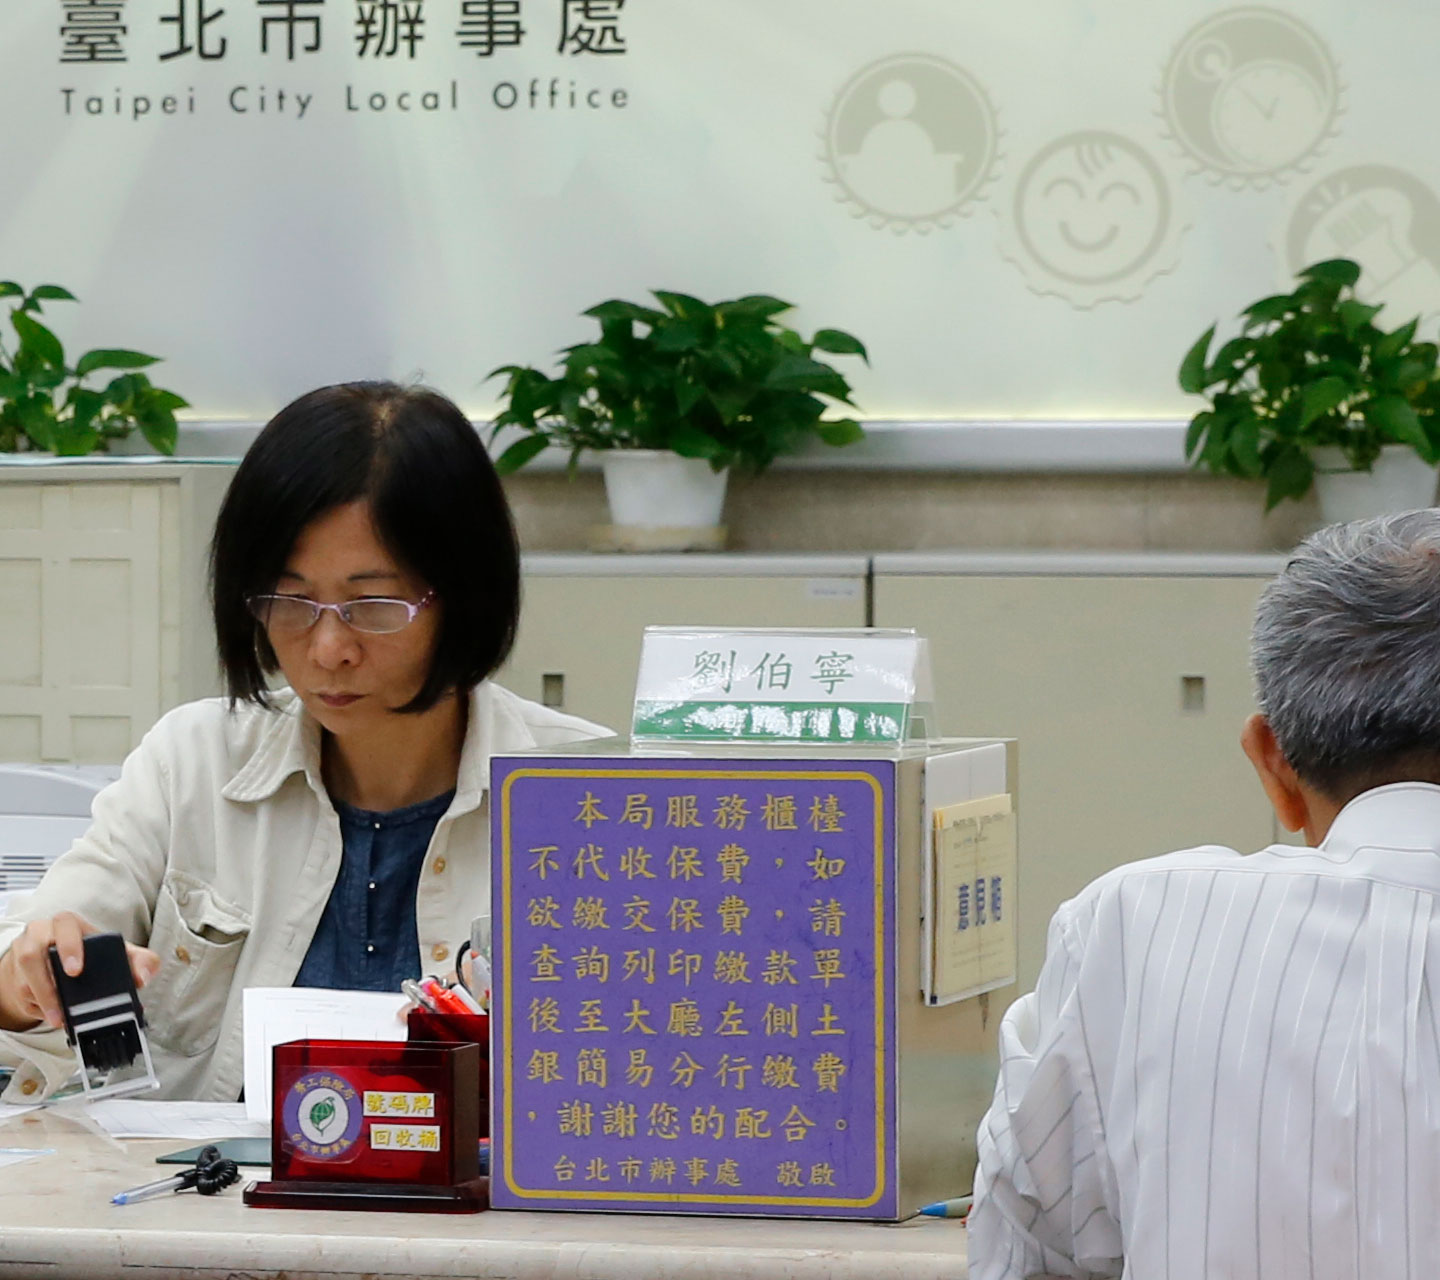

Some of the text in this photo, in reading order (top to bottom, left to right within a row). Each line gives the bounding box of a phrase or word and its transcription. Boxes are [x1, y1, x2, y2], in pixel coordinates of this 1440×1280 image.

[60, 78, 630, 119] Taipei City Local Office
[691, 649, 855, 695] 劉伯寧
[576, 792, 846, 834] 本局服務櫃檯
[528, 842, 847, 884] 不代收保費，如
[527, 894, 847, 937] 欲繳交保費，請
[529, 943, 847, 987] 查詢列印繳款單
[527, 996, 847, 1038] 後至大廳左側土
[527, 1047, 848, 1093] 銀簡易分行繳費
[365, 1093, 434, 1116] 號碼牌
[372, 1128, 438, 1149] 回收桶
[552, 1156, 837, 1188] 台北市辦事處 敬啟
